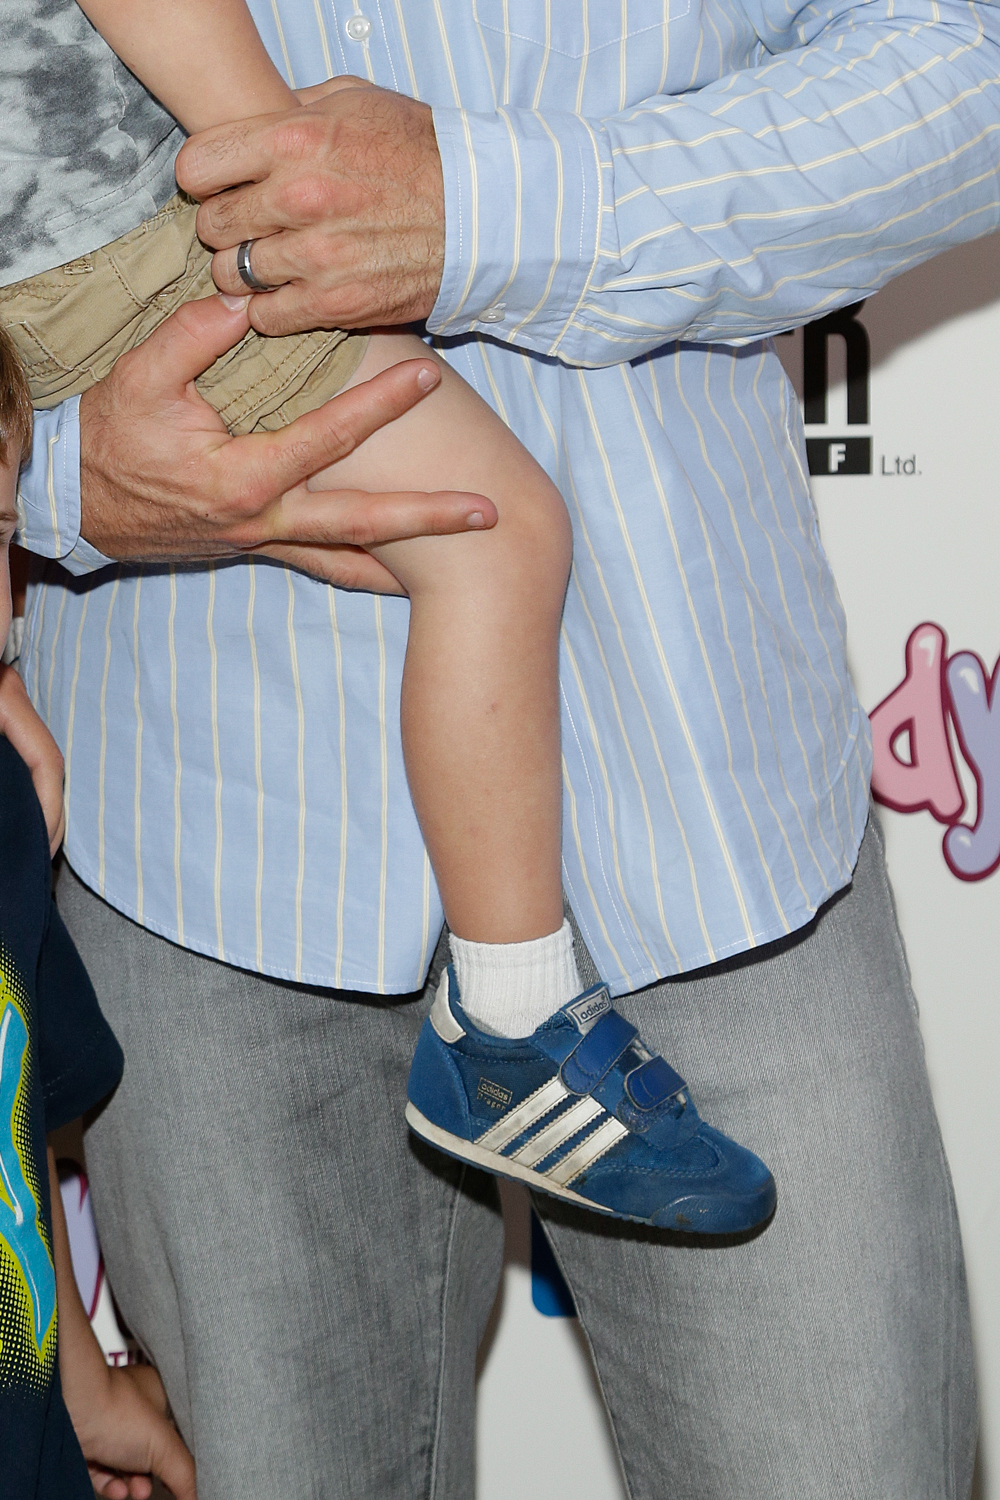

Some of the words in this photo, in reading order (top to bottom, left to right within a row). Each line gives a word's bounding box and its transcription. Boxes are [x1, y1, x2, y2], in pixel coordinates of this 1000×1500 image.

[881, 454, 922, 476] Ltd.
[580, 1000, 608, 1019] adidas
[481, 1083, 508, 1101] adidas
